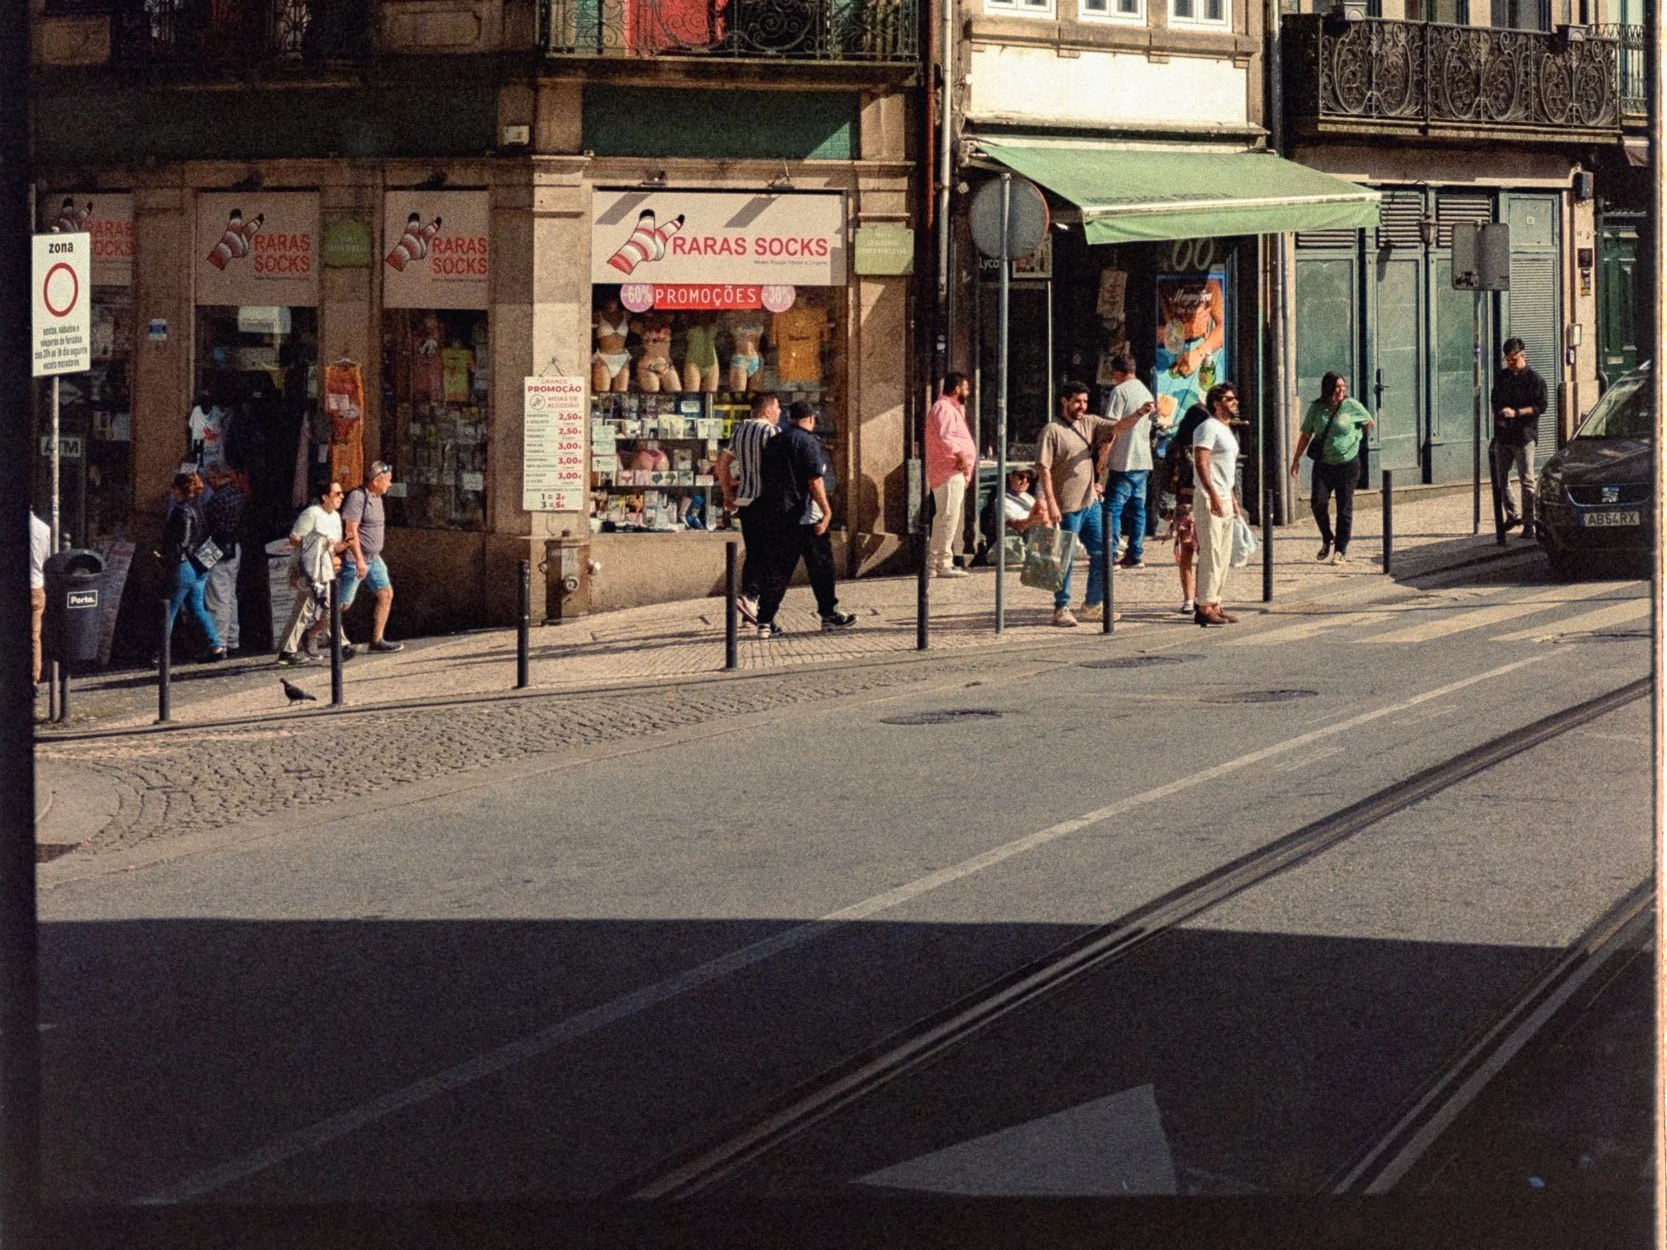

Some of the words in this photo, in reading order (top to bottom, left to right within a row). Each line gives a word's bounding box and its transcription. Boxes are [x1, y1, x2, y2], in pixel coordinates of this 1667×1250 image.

[49, 242, 73, 253] zona
[93, 240, 134, 256] OCKS
[255, 234, 310, 252] RARAS
[432, 237, 487, 254] RARAS
[672, 236, 747, 255] RARAS
[754, 237, 828, 257] SOCKS
[255, 255, 310, 273] SOCKS
[432, 257, 487, 275] SOCKS
[655, 286, 757, 306] PROMOÇÕES
[528, 384, 582, 393] PROMOÇÃO
[44, 440, 79, 453] AM
